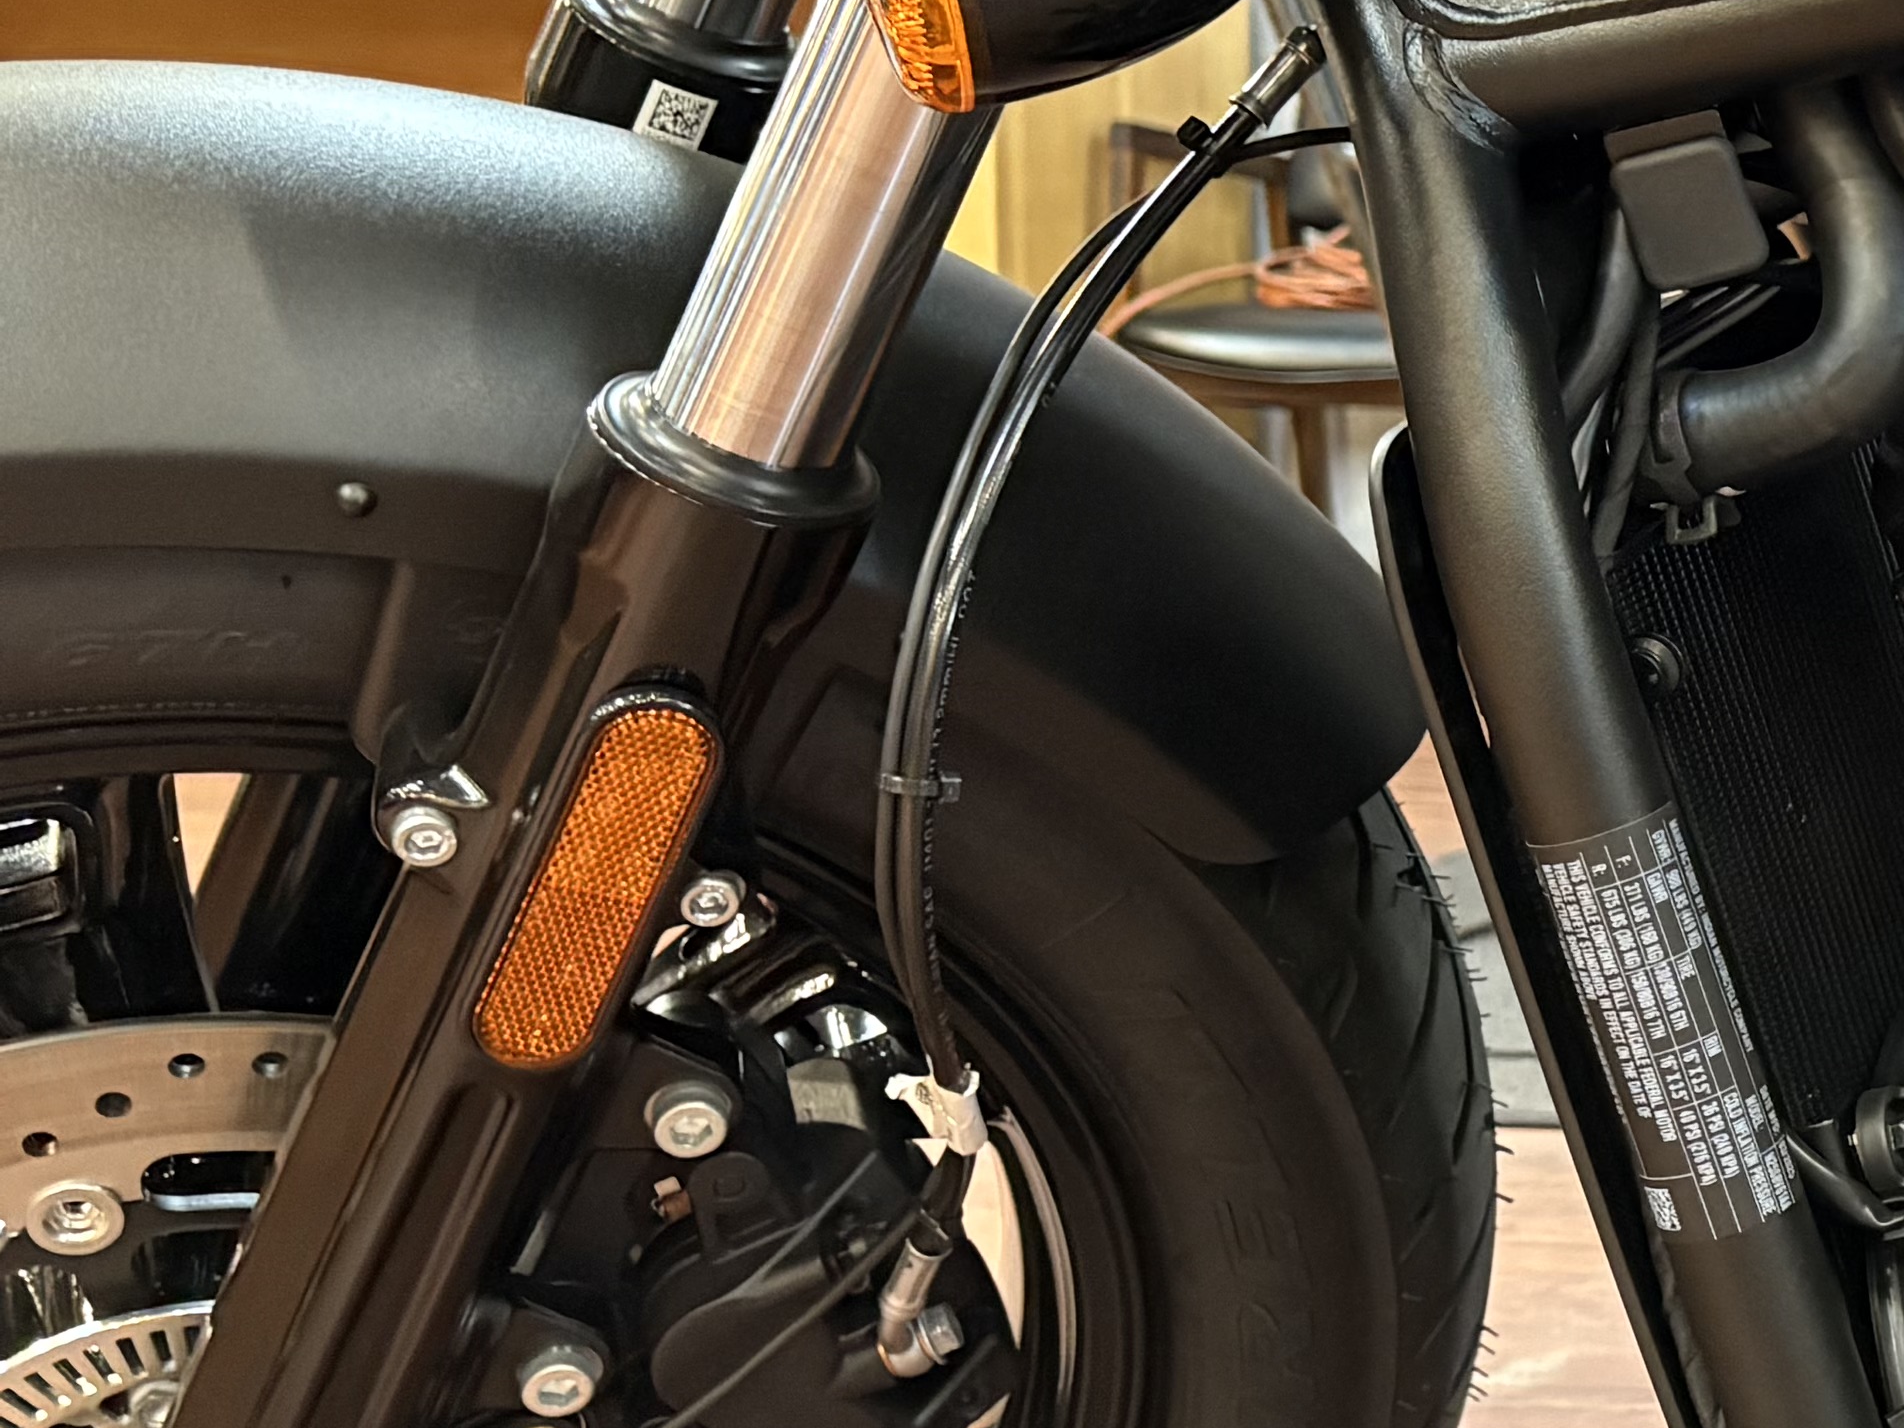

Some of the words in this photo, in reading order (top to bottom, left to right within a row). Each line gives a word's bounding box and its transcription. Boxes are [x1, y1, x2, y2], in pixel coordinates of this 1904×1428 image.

[1566, 859, 1586, 882] THIS
[1574, 882, 1600, 923] VEHICLE
[1607, 907, 1627, 927] LBS
[1630, 901, 1650, 922] LBS
[1588, 924, 1619, 975] CONFORMS
[1612, 991, 1629, 1009] ALL
[1618, 1010, 1650, 1066] APPLICABLE
[1638, 1066, 1664, 1108] FEDERAL
[1723, 1091, 1742, 1118] COLD
[1653, 1109, 1677, 1141] MOTOR
[1683, 1122, 1701, 1140] PSI
[1706, 1113, 1725, 1132] PSI
[1731, 1117, 1759, 1167] INFLATION
[1748, 1165, 1776, 1215] PRESSURE
